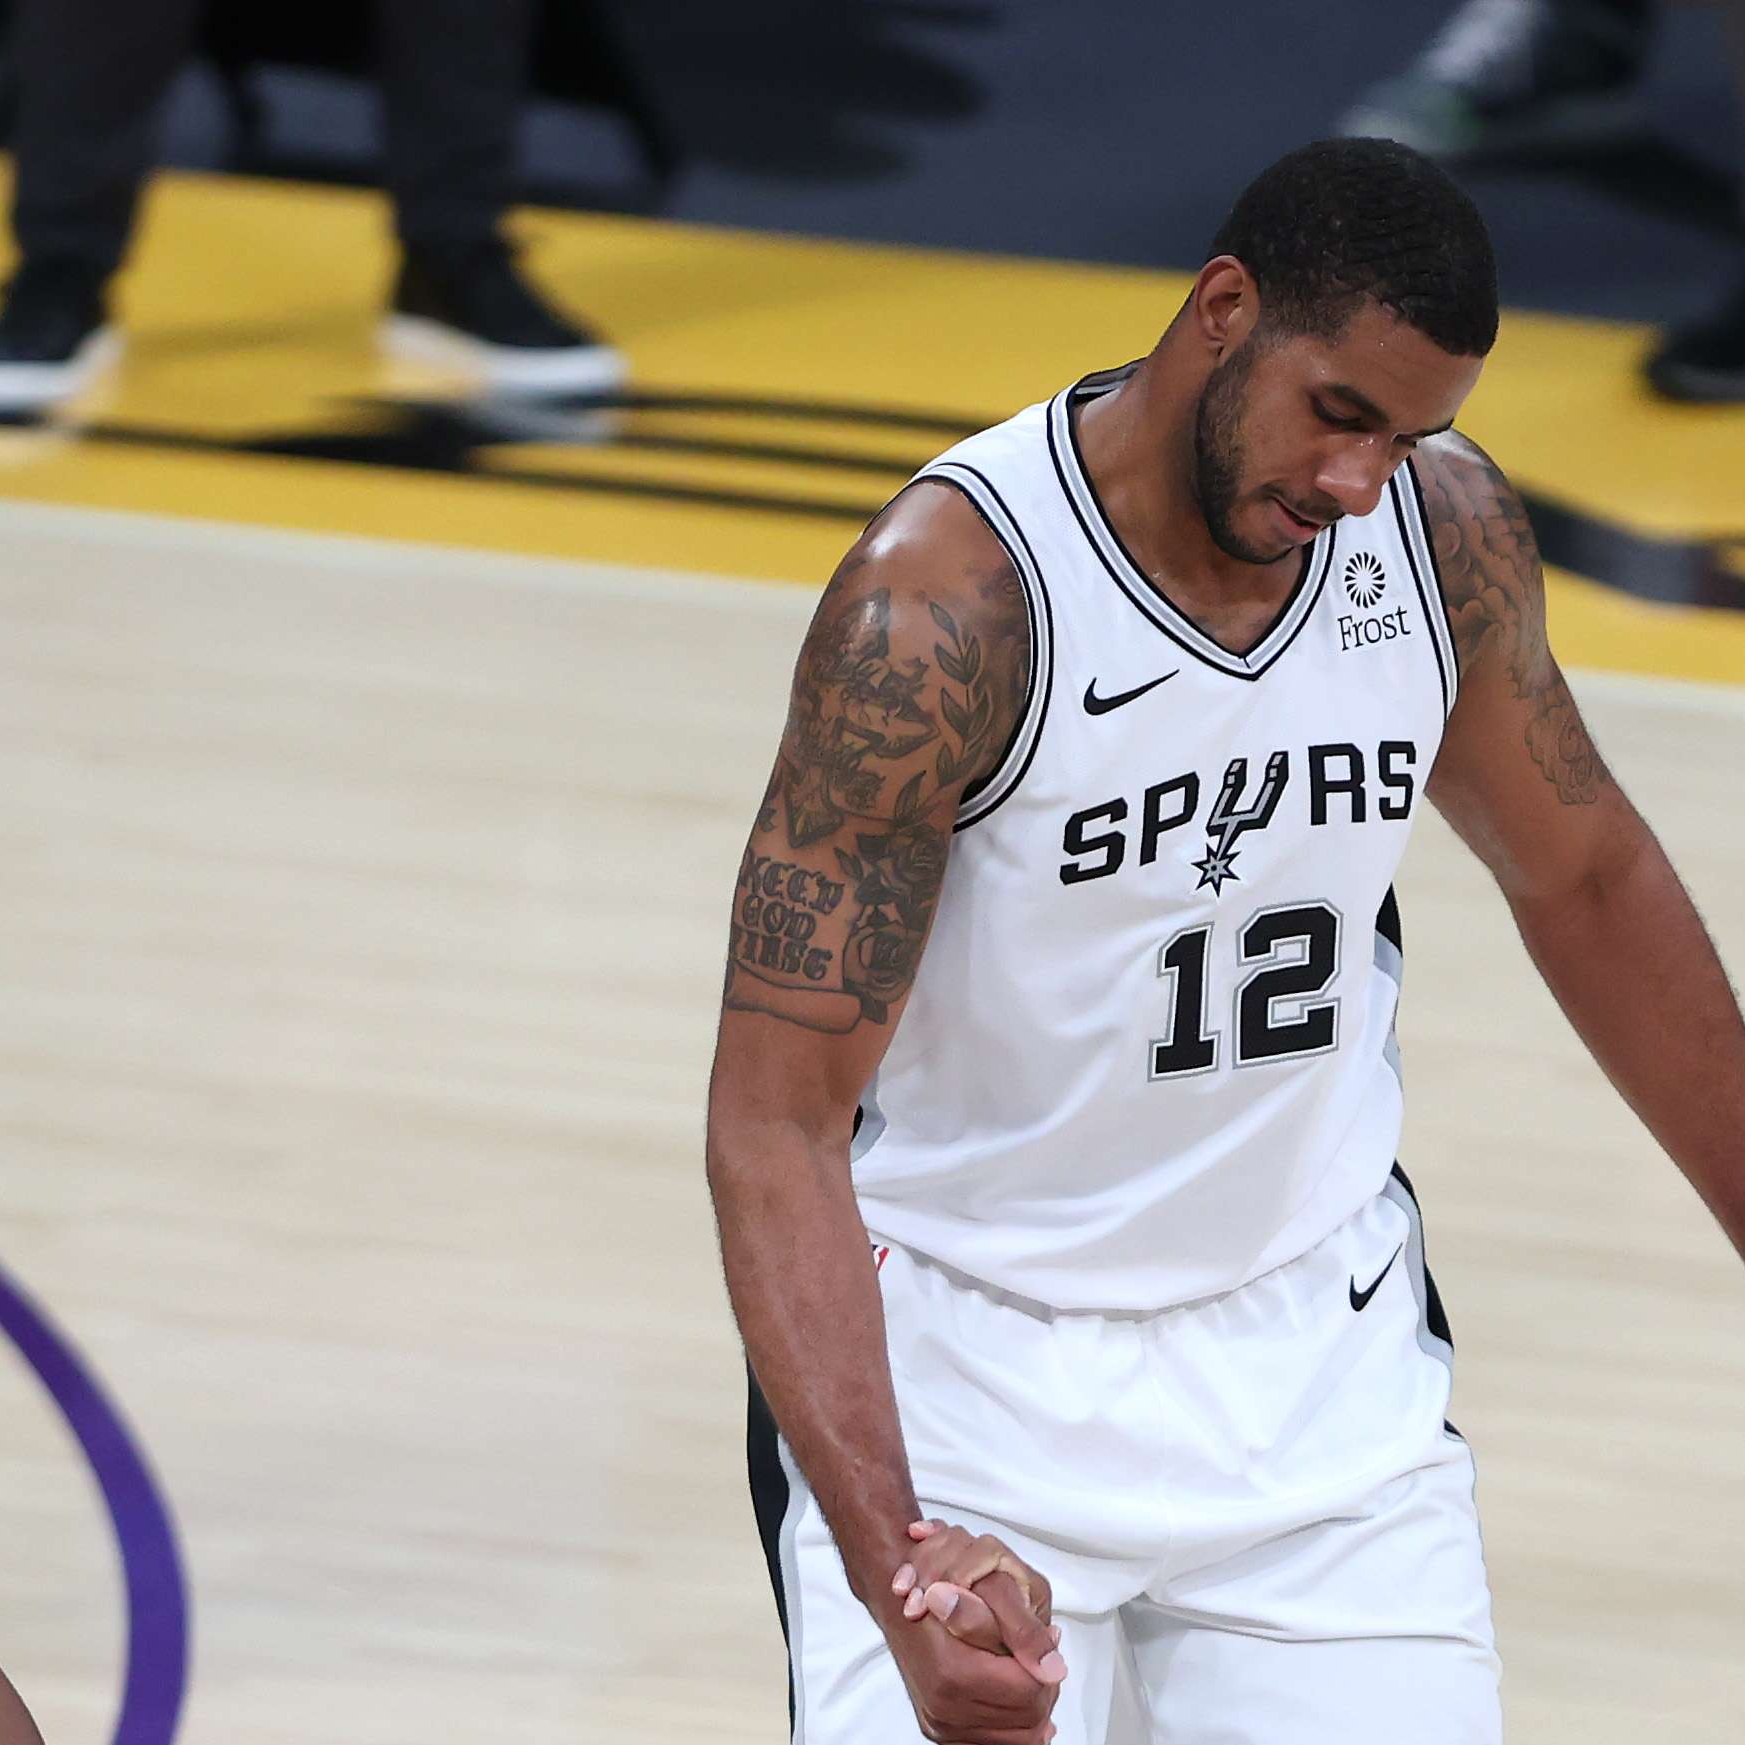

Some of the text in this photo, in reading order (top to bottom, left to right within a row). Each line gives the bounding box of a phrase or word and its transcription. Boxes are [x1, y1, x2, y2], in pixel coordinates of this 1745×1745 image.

[1337, 604, 1411, 651] Frost
[1059, 740, 1418, 897] SPURS
[1147, 897, 1344, 1083] 12
